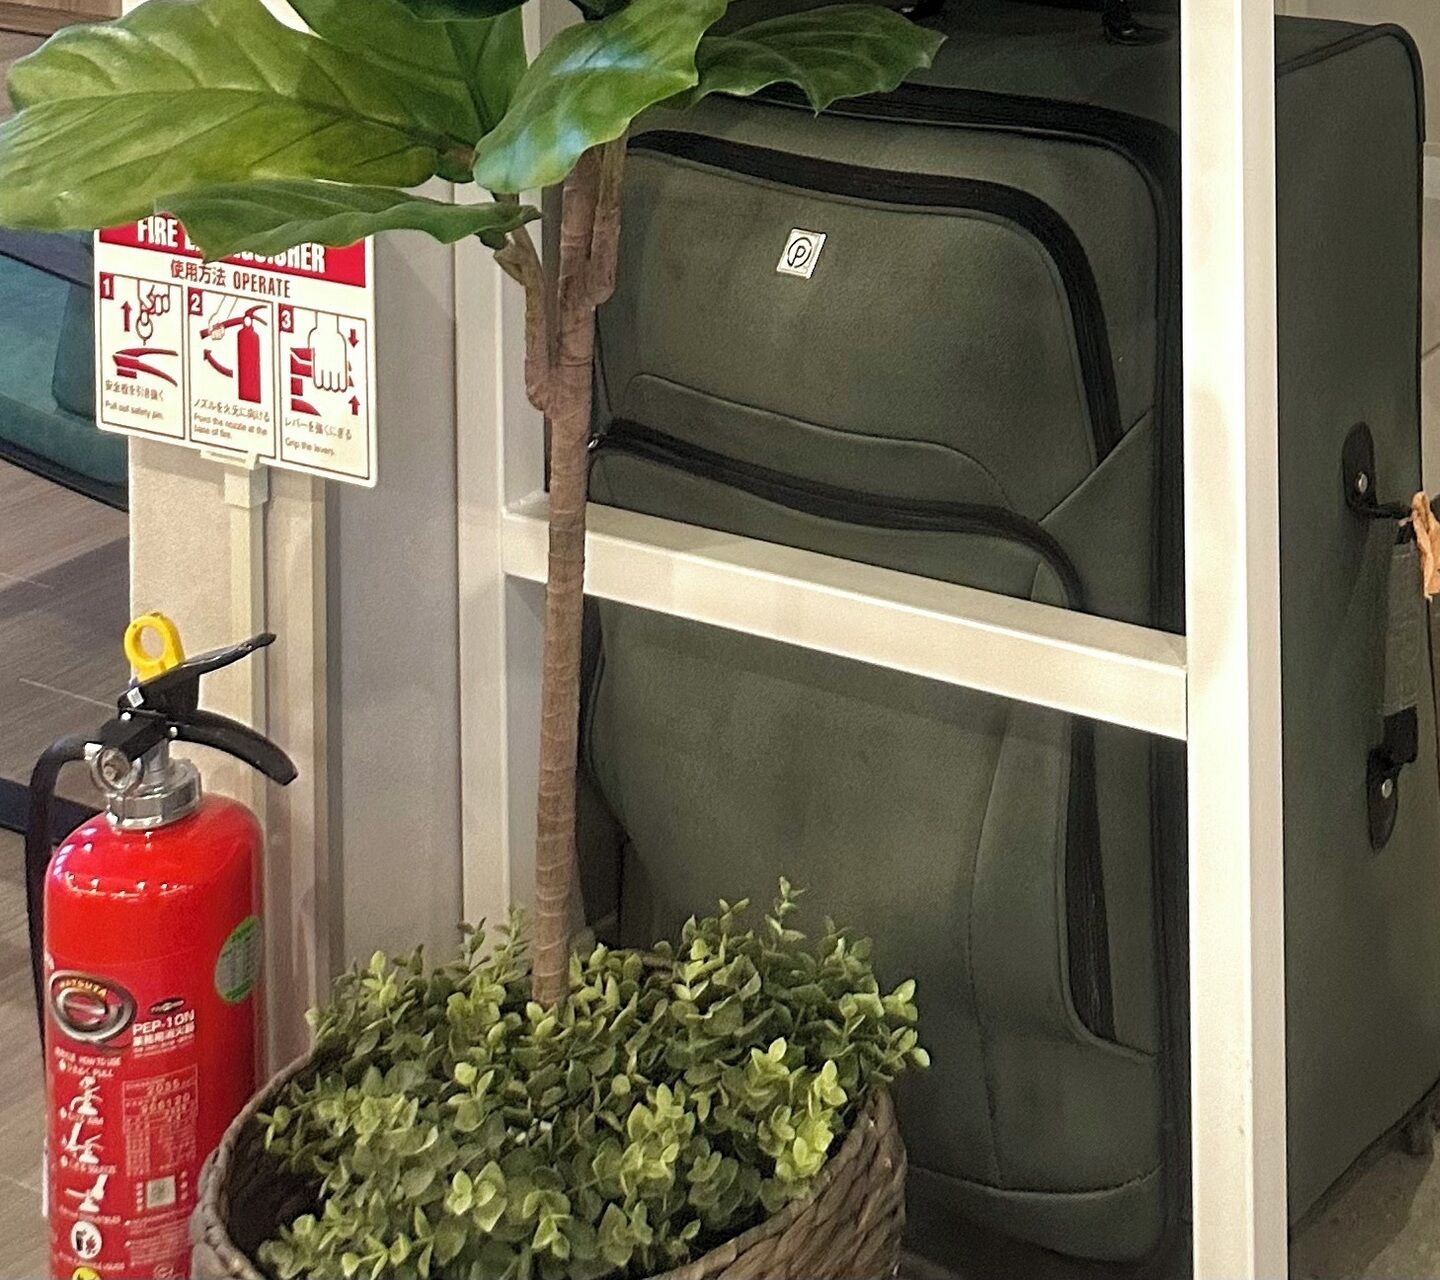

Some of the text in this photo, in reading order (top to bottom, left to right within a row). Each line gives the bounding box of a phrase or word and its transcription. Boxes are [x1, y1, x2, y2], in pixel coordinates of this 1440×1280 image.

[137, 215, 179, 248] FIRE
[102, 277, 112, 297] 1
[170, 258, 291, 299] 使用方法 OPERATE
[190, 293, 201, 313] 2
[281, 310, 292, 330] 3
[132, 1008, 196, 1036] PEP-10N
